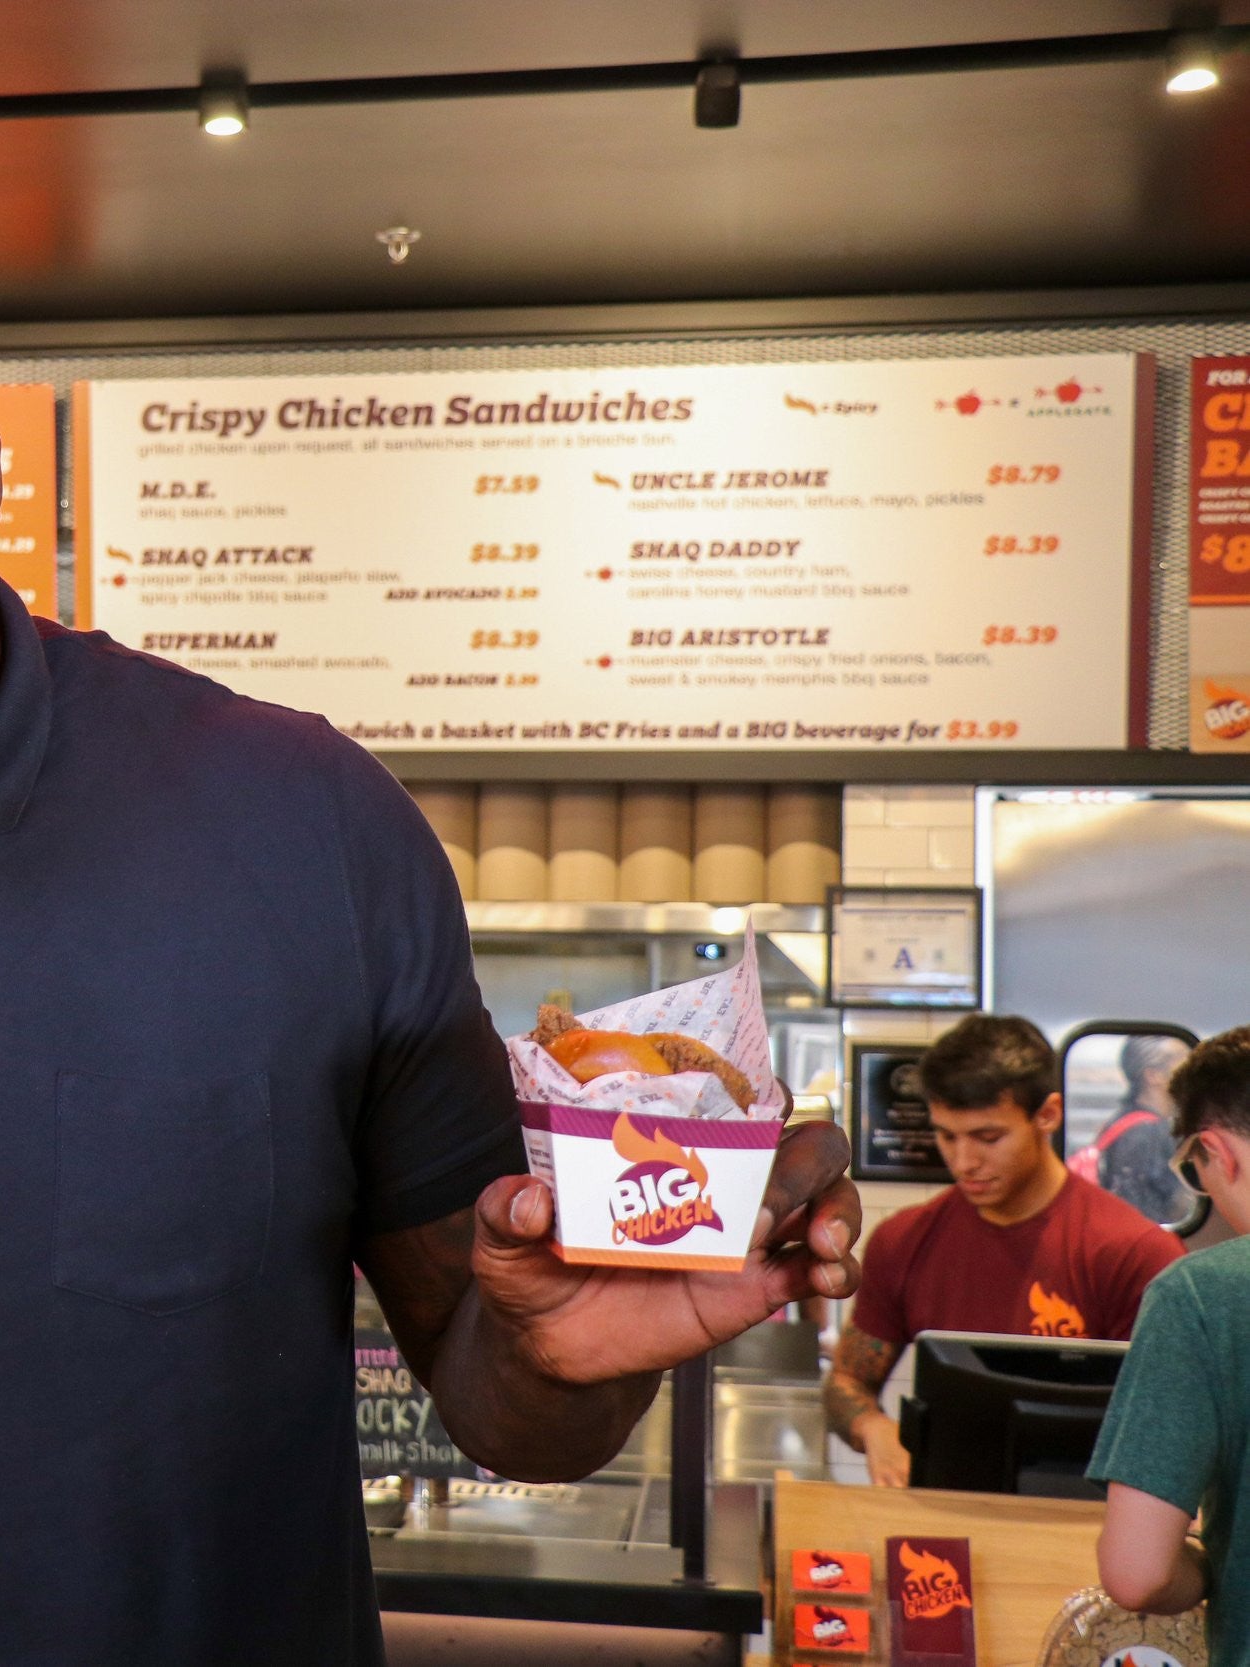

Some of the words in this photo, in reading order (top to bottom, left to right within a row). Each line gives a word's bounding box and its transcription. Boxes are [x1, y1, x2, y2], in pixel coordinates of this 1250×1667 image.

[141, 402, 267, 437] Crispy
[277, 396, 434, 429] Chicken
[444, 391, 693, 426] Sandwiches
[631, 471, 716, 491] UNCLE
[722, 468, 830, 489] JEROME
[986, 463, 1062, 487] $8.79
[139, 480, 216, 499] M.D.E.
[924, 491, 986, 508] pickles
[139, 547, 208, 567] SHAQ
[214, 545, 315, 565] ATTACK
[629, 541, 702, 562] SHAQ
[708, 539, 801, 559] DADDY
[983, 534, 1060, 556] $8.39
[860, 583, 910, 597] sauce
[140, 631, 278, 651] SUPERMAN
[629, 629, 673, 648] BIG
[680, 627, 831, 647] ARISTOTLE
[981, 624, 1059, 646] $8.39
[829, 650, 864, 667] fried
[934, 651, 992, 668] bacon,
[880, 672, 930, 687] sauce
[1204, 701, 1249, 730] BIG
[440, 720, 515, 739] basket
[521, 720, 571, 739] with
[578, 722, 611, 739] BC
[614, 720, 671, 739] Fries
[677, 720, 721, 739] and
[745, 720, 787, 739] BIG
[794, 720, 901, 743] beverage
[904, 719, 941, 743] for
[945, 719, 1020, 741] $3.99
[892, 947, 915, 970] A
[610, 1167, 702, 1220] BIG
[611, 1194, 714, 1246] CHICKEN
[356, 1367, 412, 1396] SHAQ
[905, 1572, 952, 1601] BIG
[903, 1584, 964, 1620] CHICKEN
